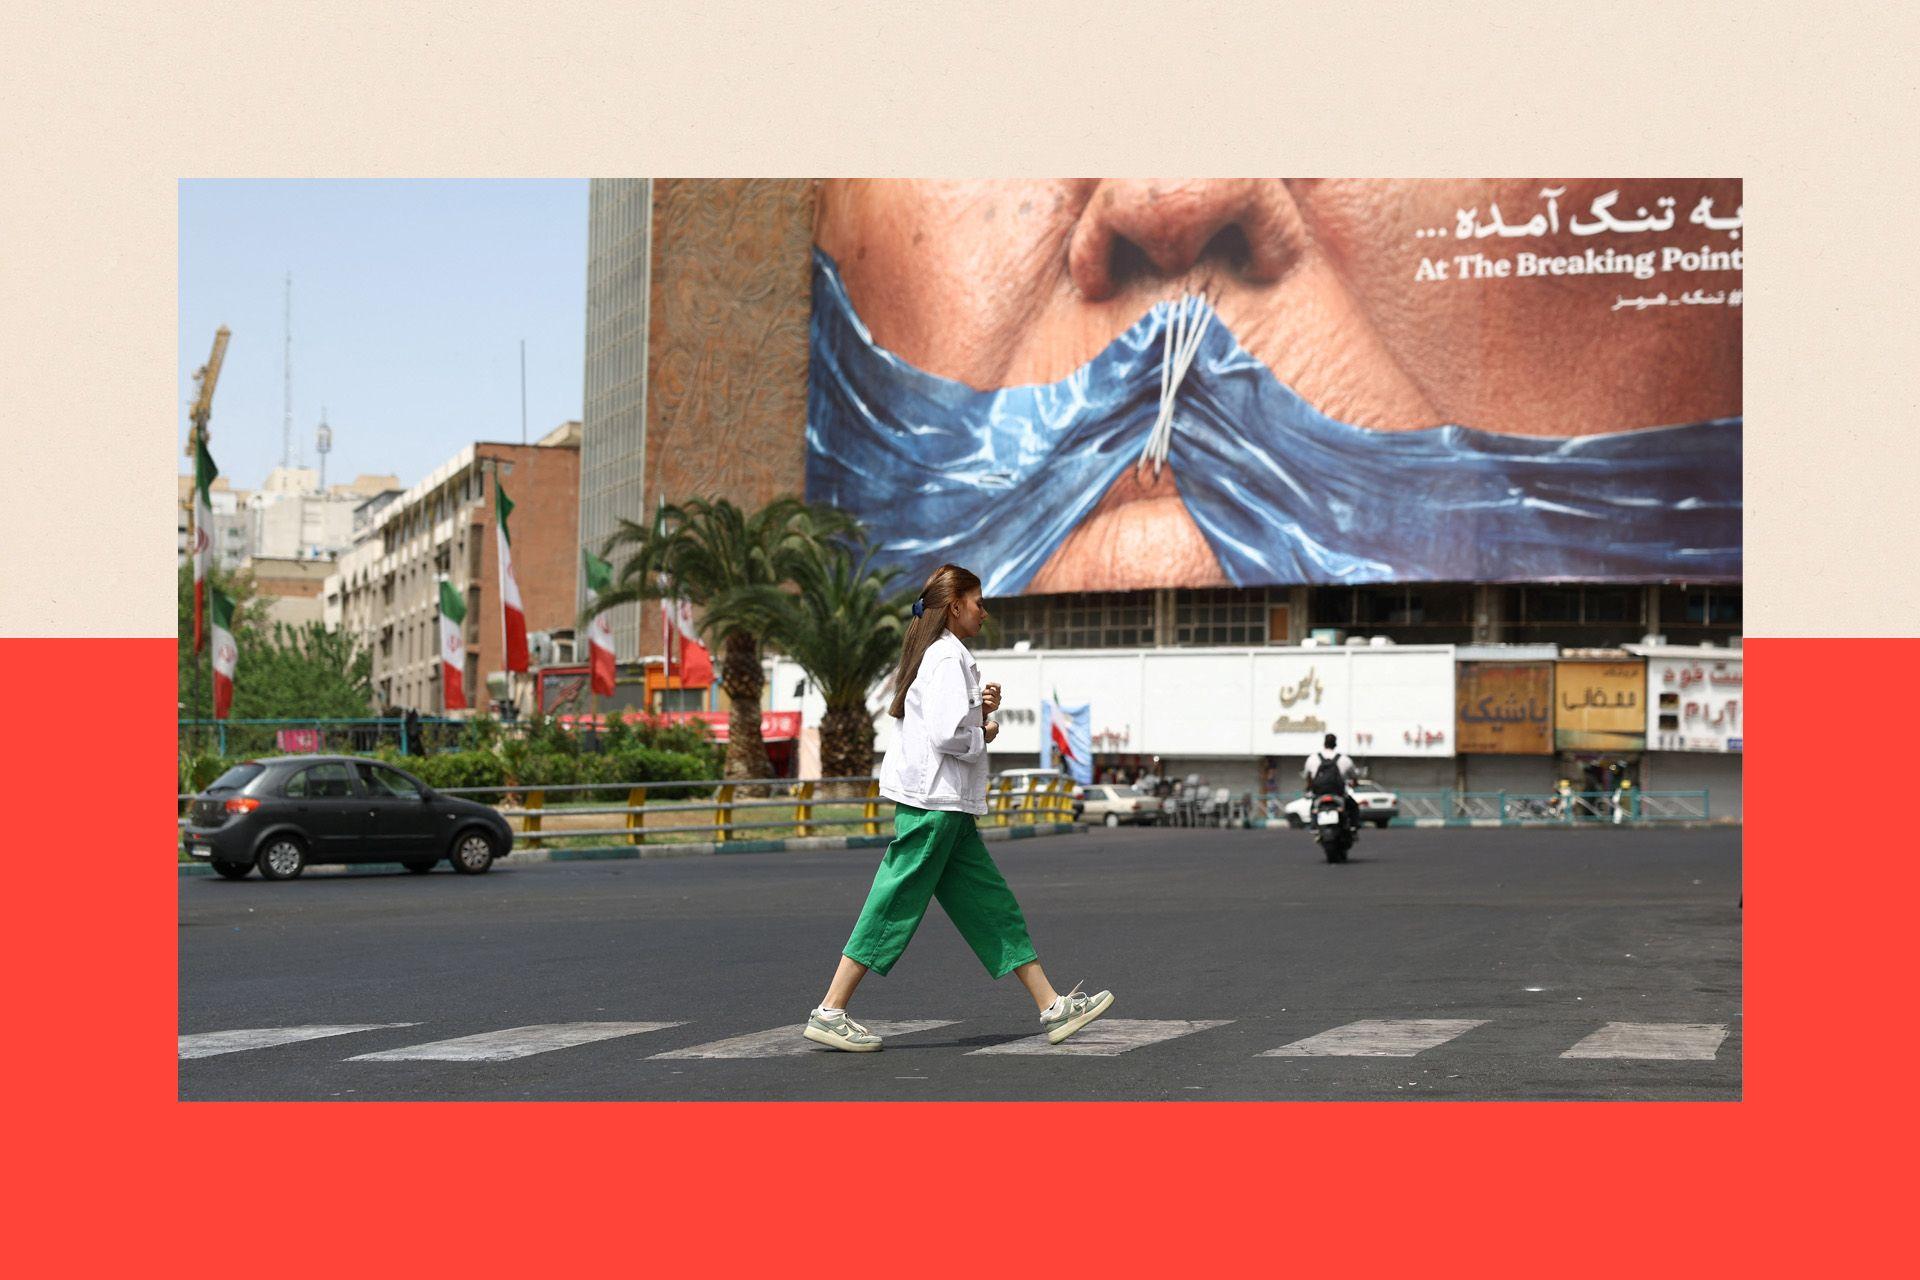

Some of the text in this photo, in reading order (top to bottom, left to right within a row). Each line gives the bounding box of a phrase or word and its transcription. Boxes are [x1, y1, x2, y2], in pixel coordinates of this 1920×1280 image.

[1414, 245, 1743, 282] At The Breaking Point
